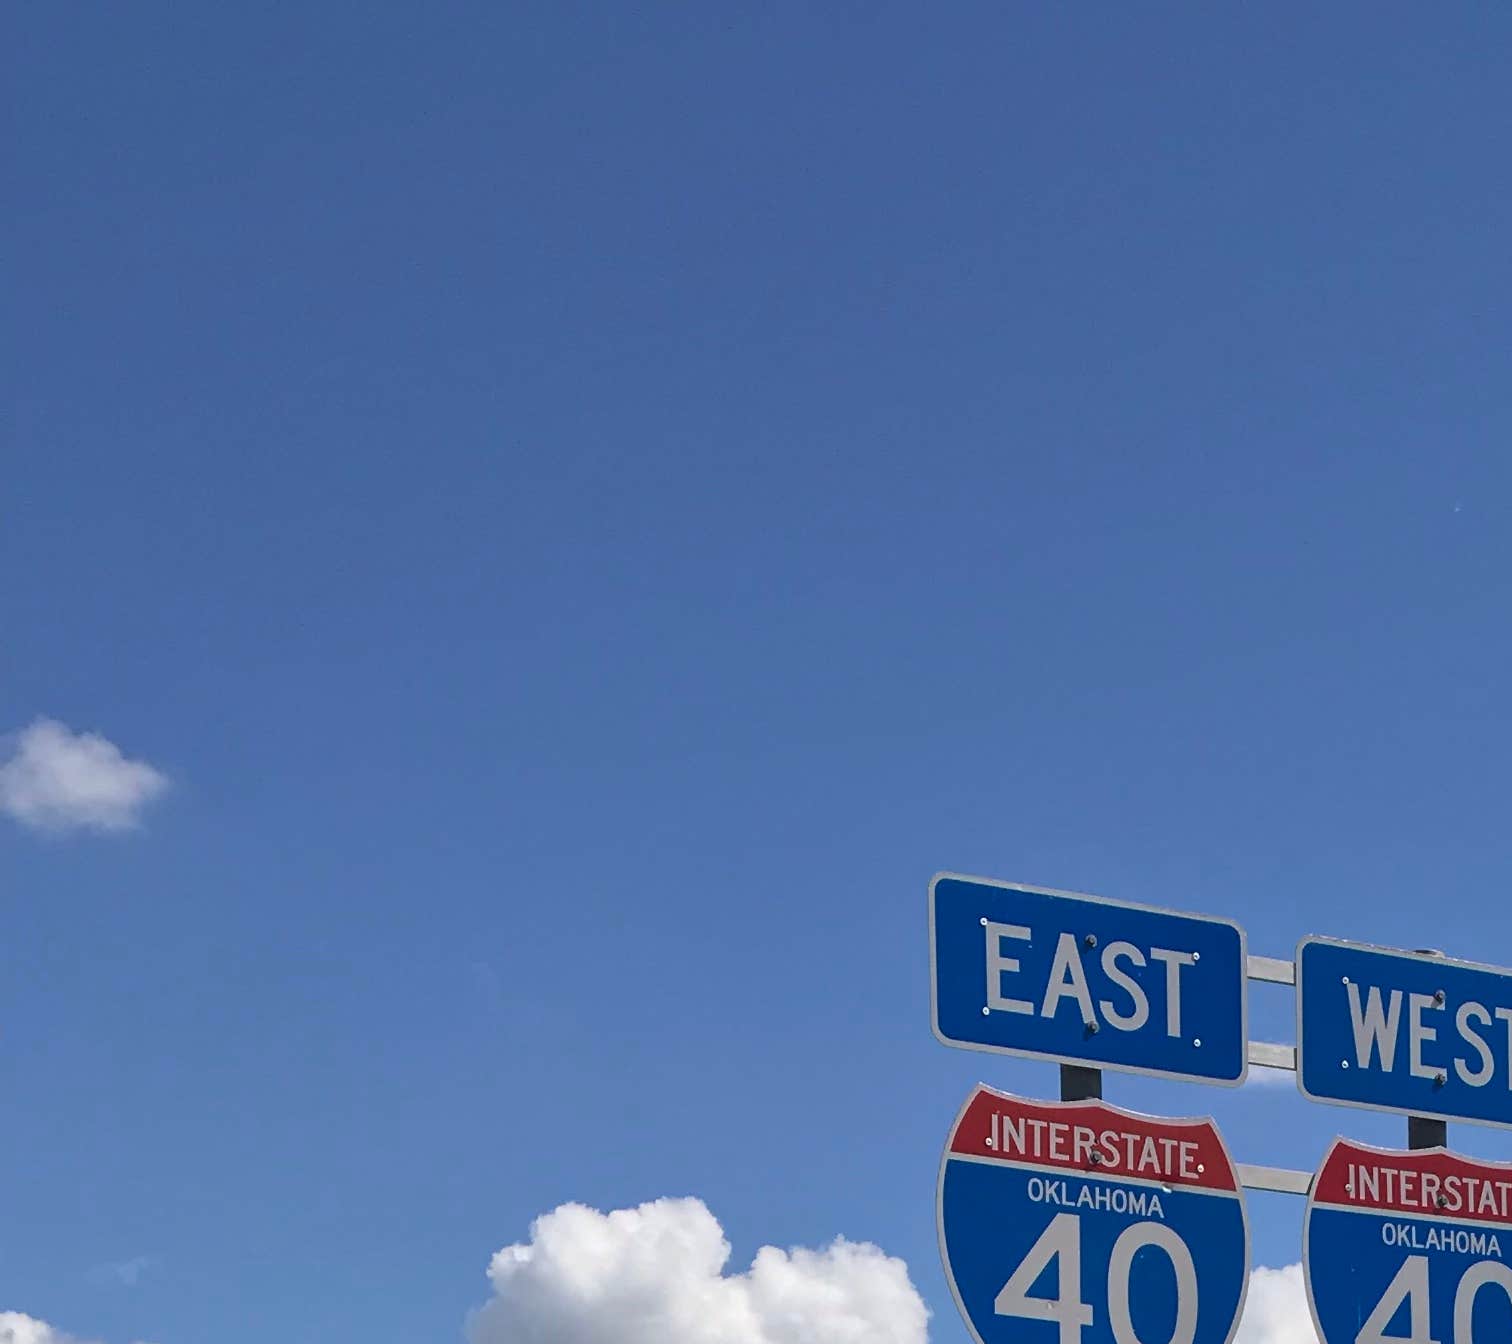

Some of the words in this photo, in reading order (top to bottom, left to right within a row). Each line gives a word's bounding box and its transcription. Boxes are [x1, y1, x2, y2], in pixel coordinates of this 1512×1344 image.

[985, 921, 1196, 1038] EAST
[991, 1113, 1199, 1179] INTERSTATE
[1028, 1178, 1164, 1219] OKLAHOMA
[1382, 1223, 1502, 1258] OKLAHOMA
